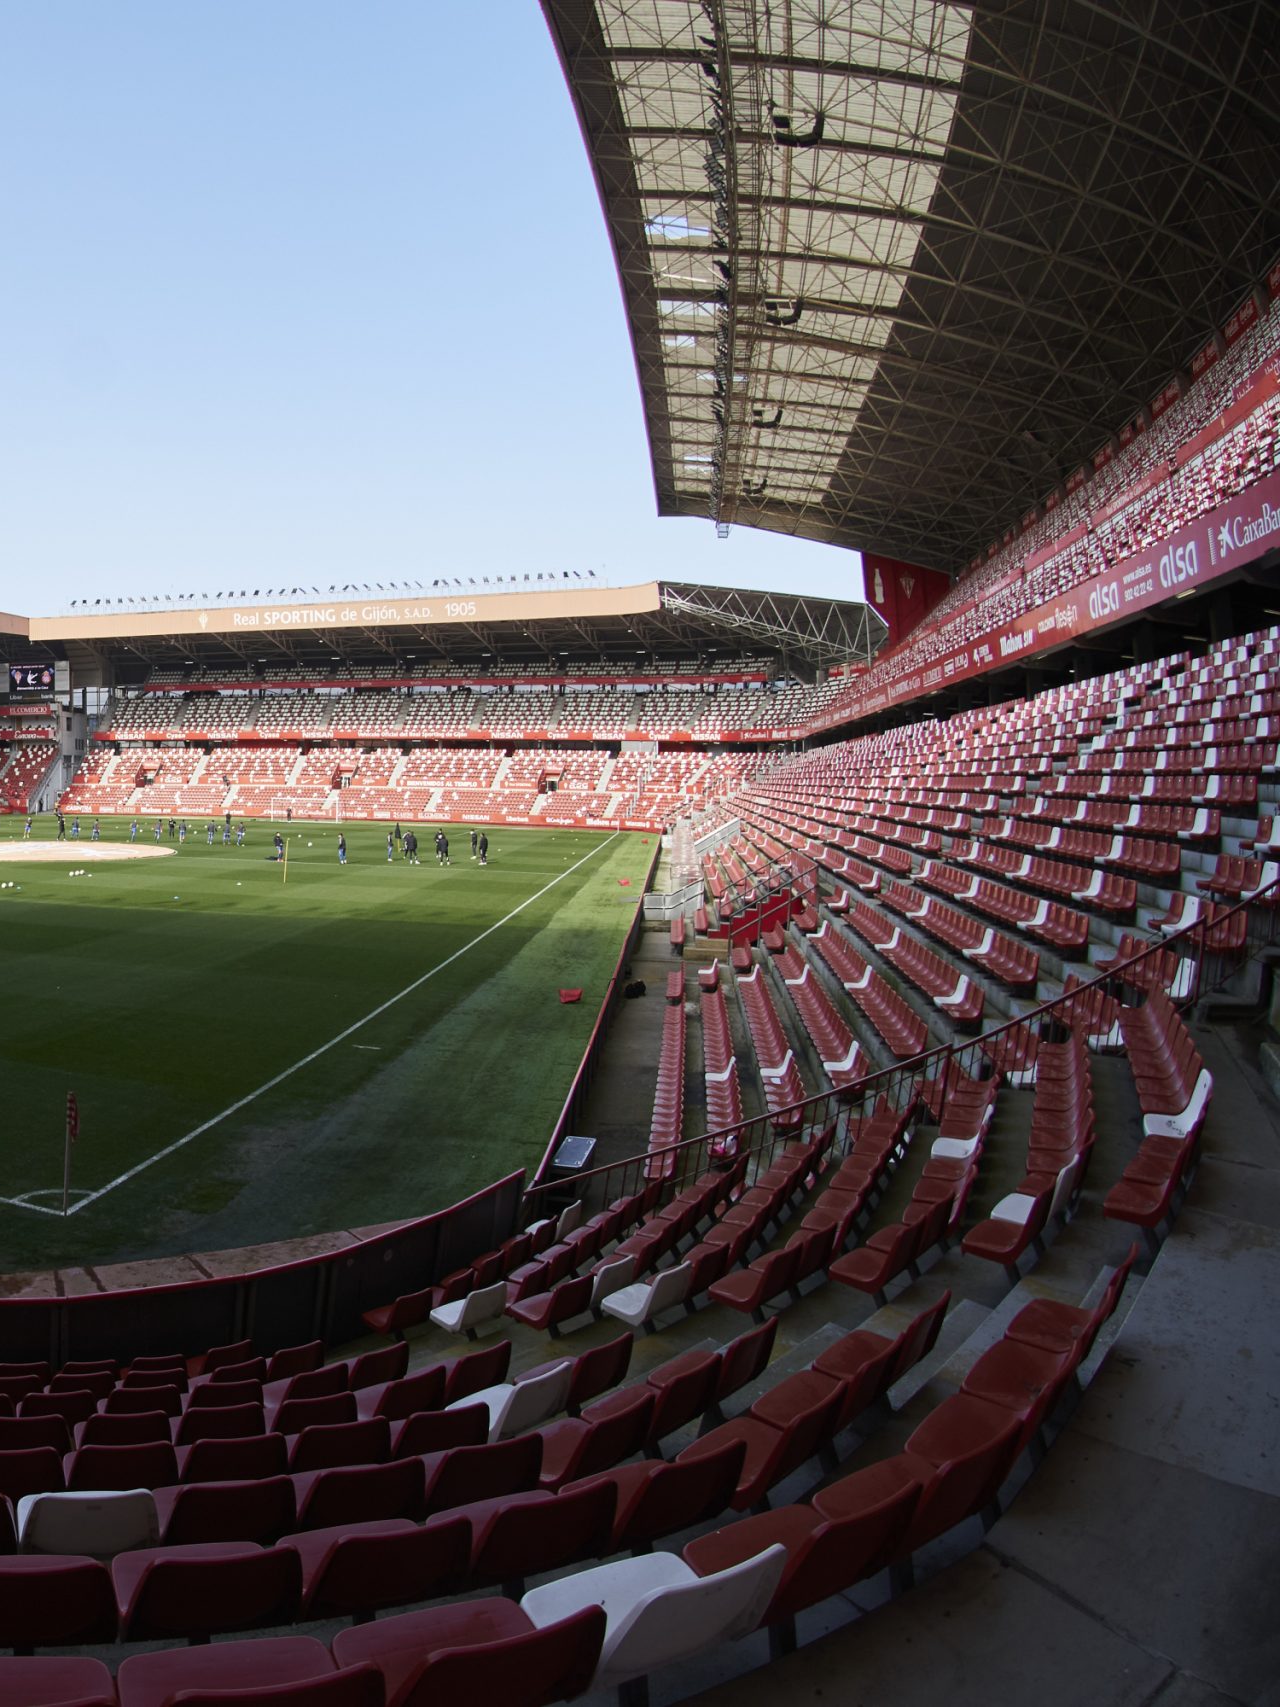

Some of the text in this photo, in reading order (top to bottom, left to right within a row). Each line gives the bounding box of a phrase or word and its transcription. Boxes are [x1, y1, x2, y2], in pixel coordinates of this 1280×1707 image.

[1160, 540, 1198, 588] alsa
[234, 602, 476, 626] Real SPORTING de Gijón, S.A.D. 1905
[1089, 581, 1119, 619] alsa
